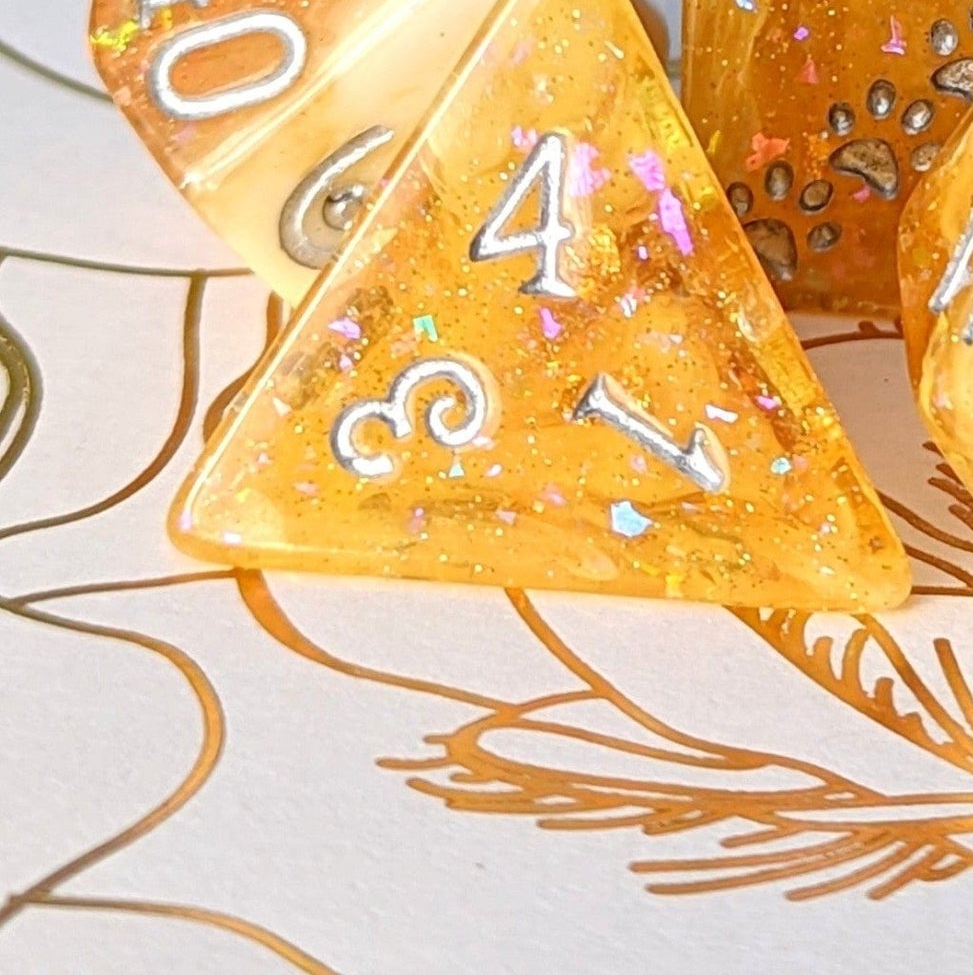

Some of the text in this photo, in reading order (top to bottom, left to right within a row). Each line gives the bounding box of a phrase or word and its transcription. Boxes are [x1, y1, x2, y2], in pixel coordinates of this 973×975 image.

[470, 131, 578, 299] 4
[330, 358, 487, 478] 3
[570, 373, 727, 492] 1
